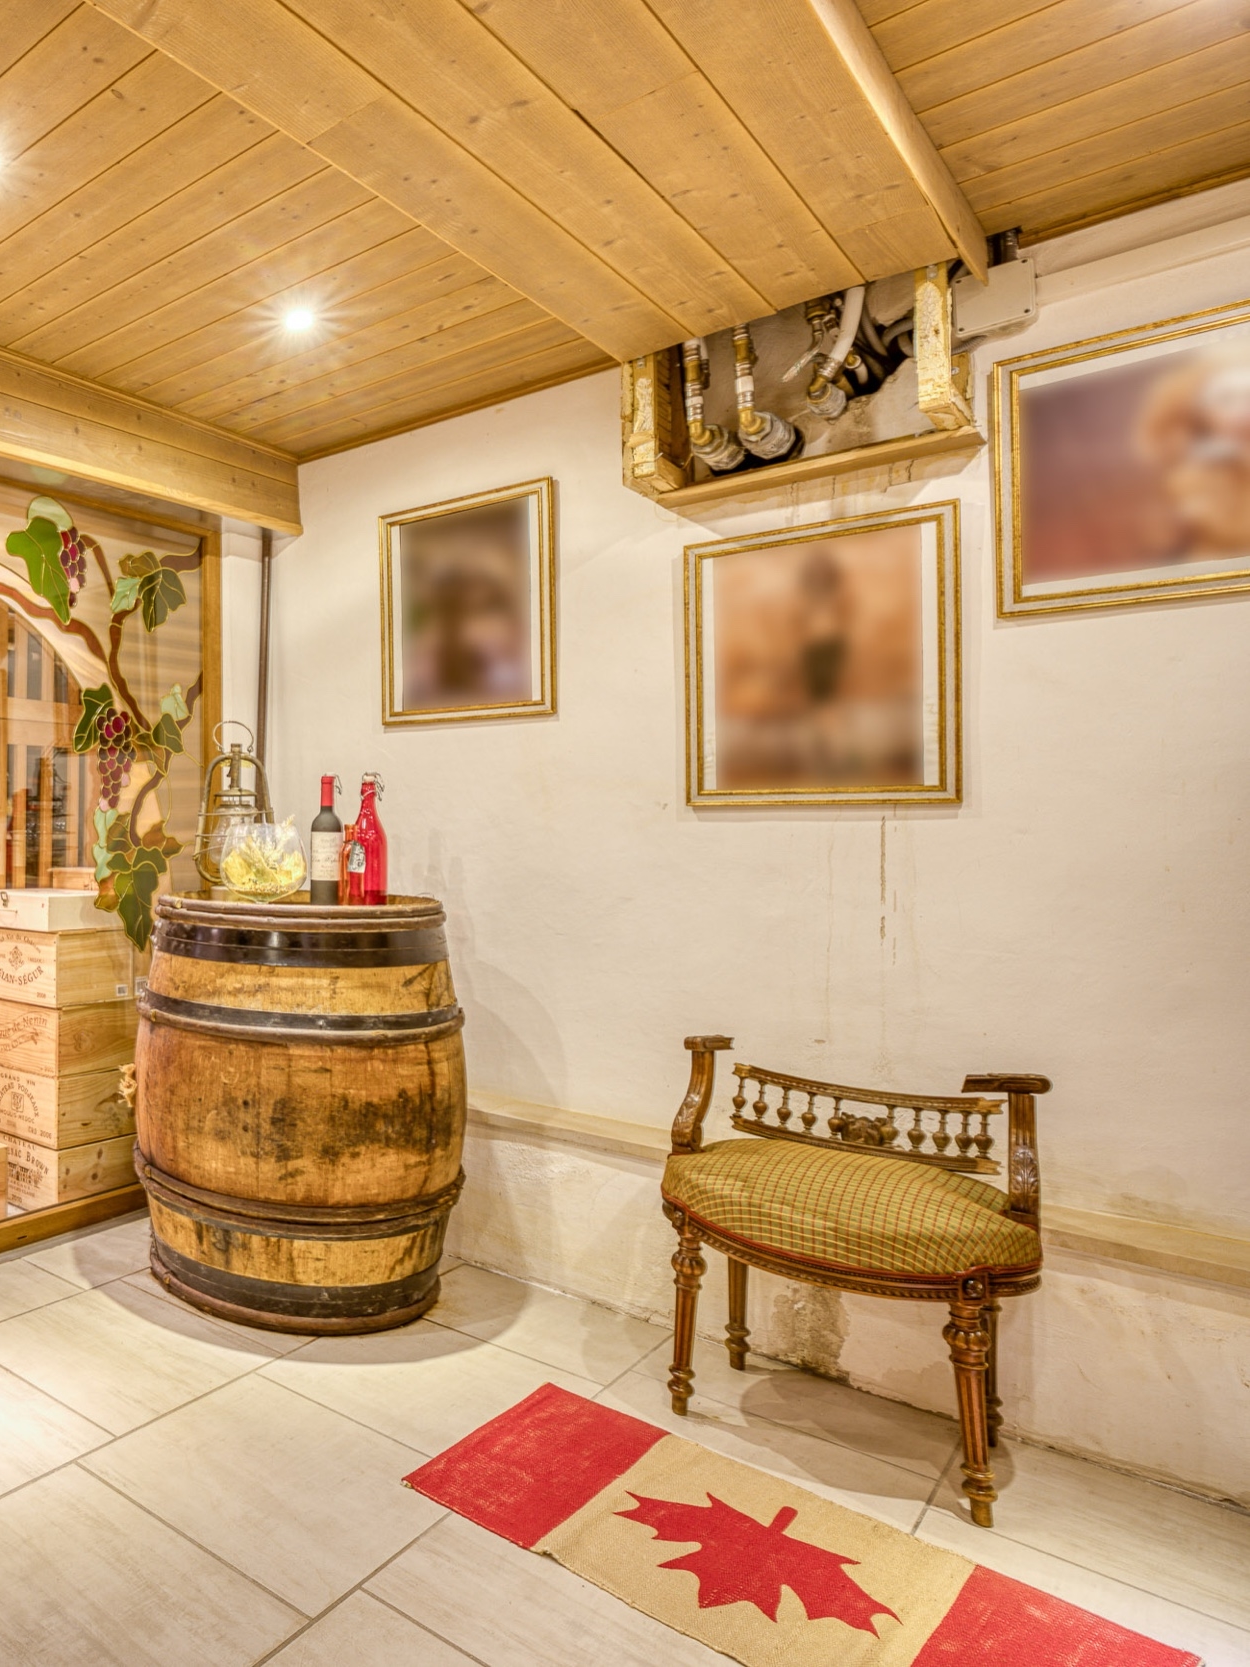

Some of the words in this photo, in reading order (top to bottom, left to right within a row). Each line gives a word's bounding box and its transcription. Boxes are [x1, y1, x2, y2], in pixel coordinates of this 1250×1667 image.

[22, 1015, 48, 1029] Nenin
[0, 1073, 20, 1082] GRAND
[18, 1083, 40, 1118] POUJEAUX
[3, 1134, 37, 1151] CHATEAU
